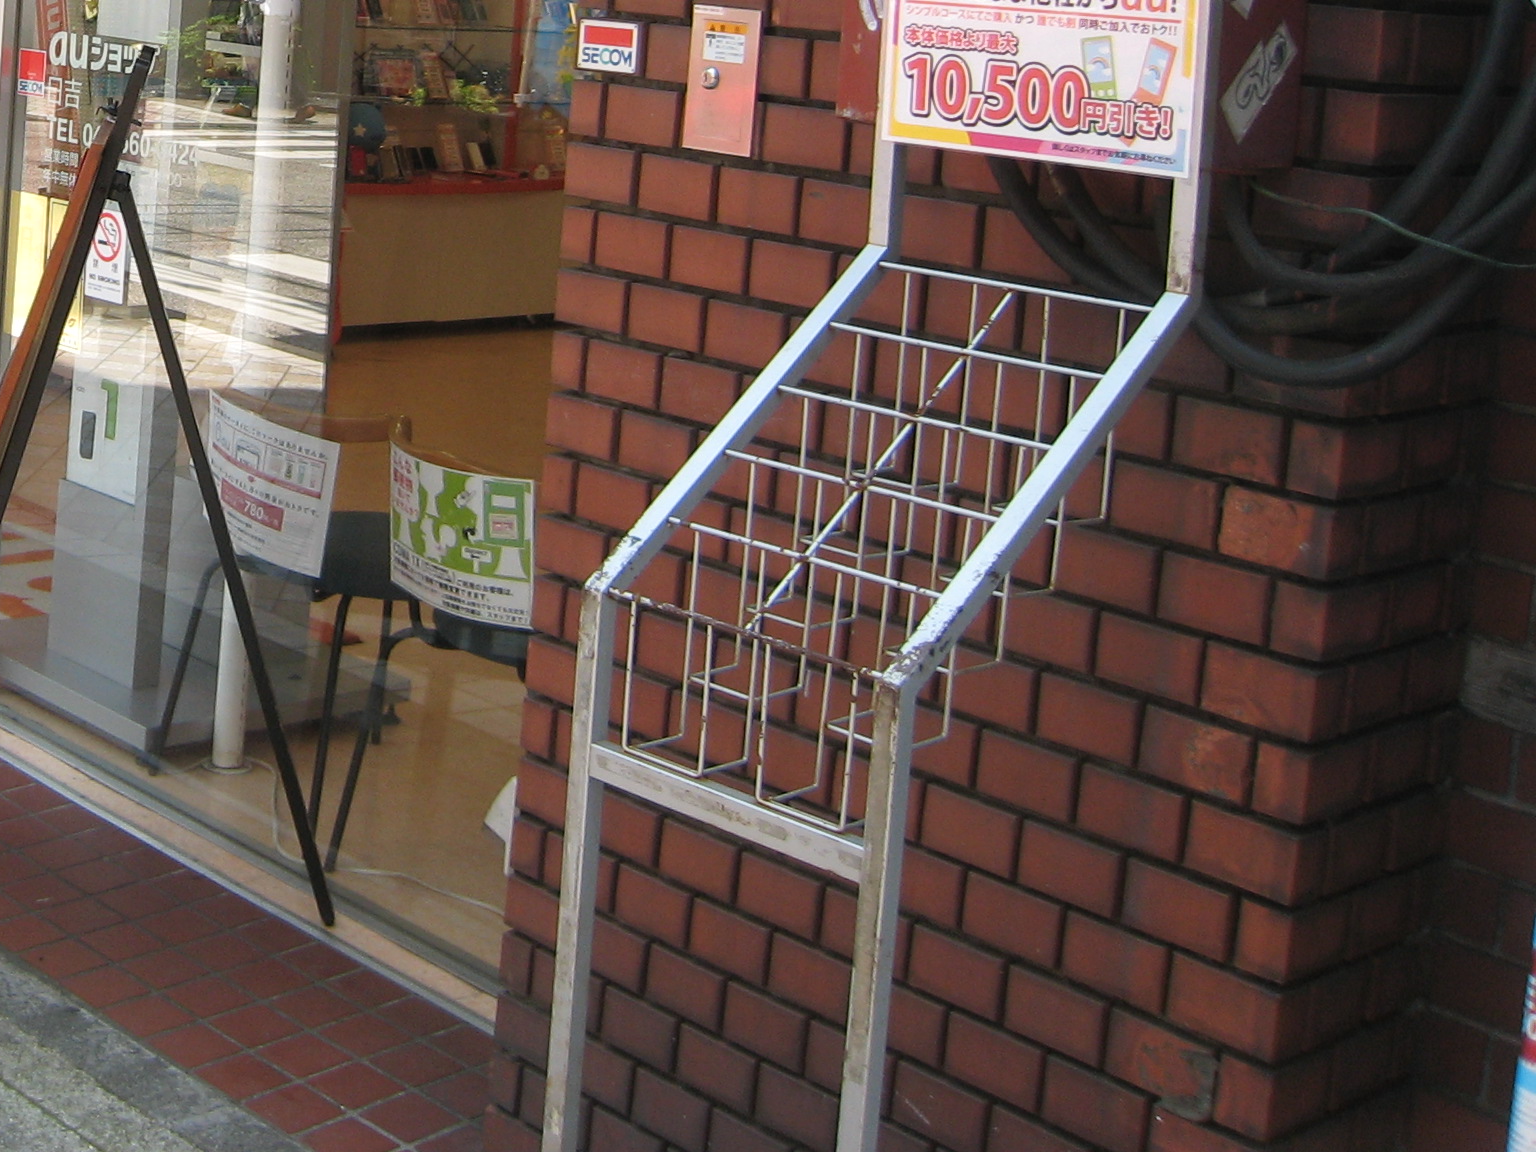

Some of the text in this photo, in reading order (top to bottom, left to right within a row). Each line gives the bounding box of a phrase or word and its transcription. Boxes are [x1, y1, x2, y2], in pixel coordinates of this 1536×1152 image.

[1015, 14, 1035, 25] かつ
[904, 23, 1020, 56] 本体価格より最大
[581, 46, 633, 68] SECOM
[19, 80, 43, 94] SECOM
[48, 76, 83, 110] 日吉
[47, 116, 80, 146] TEL
